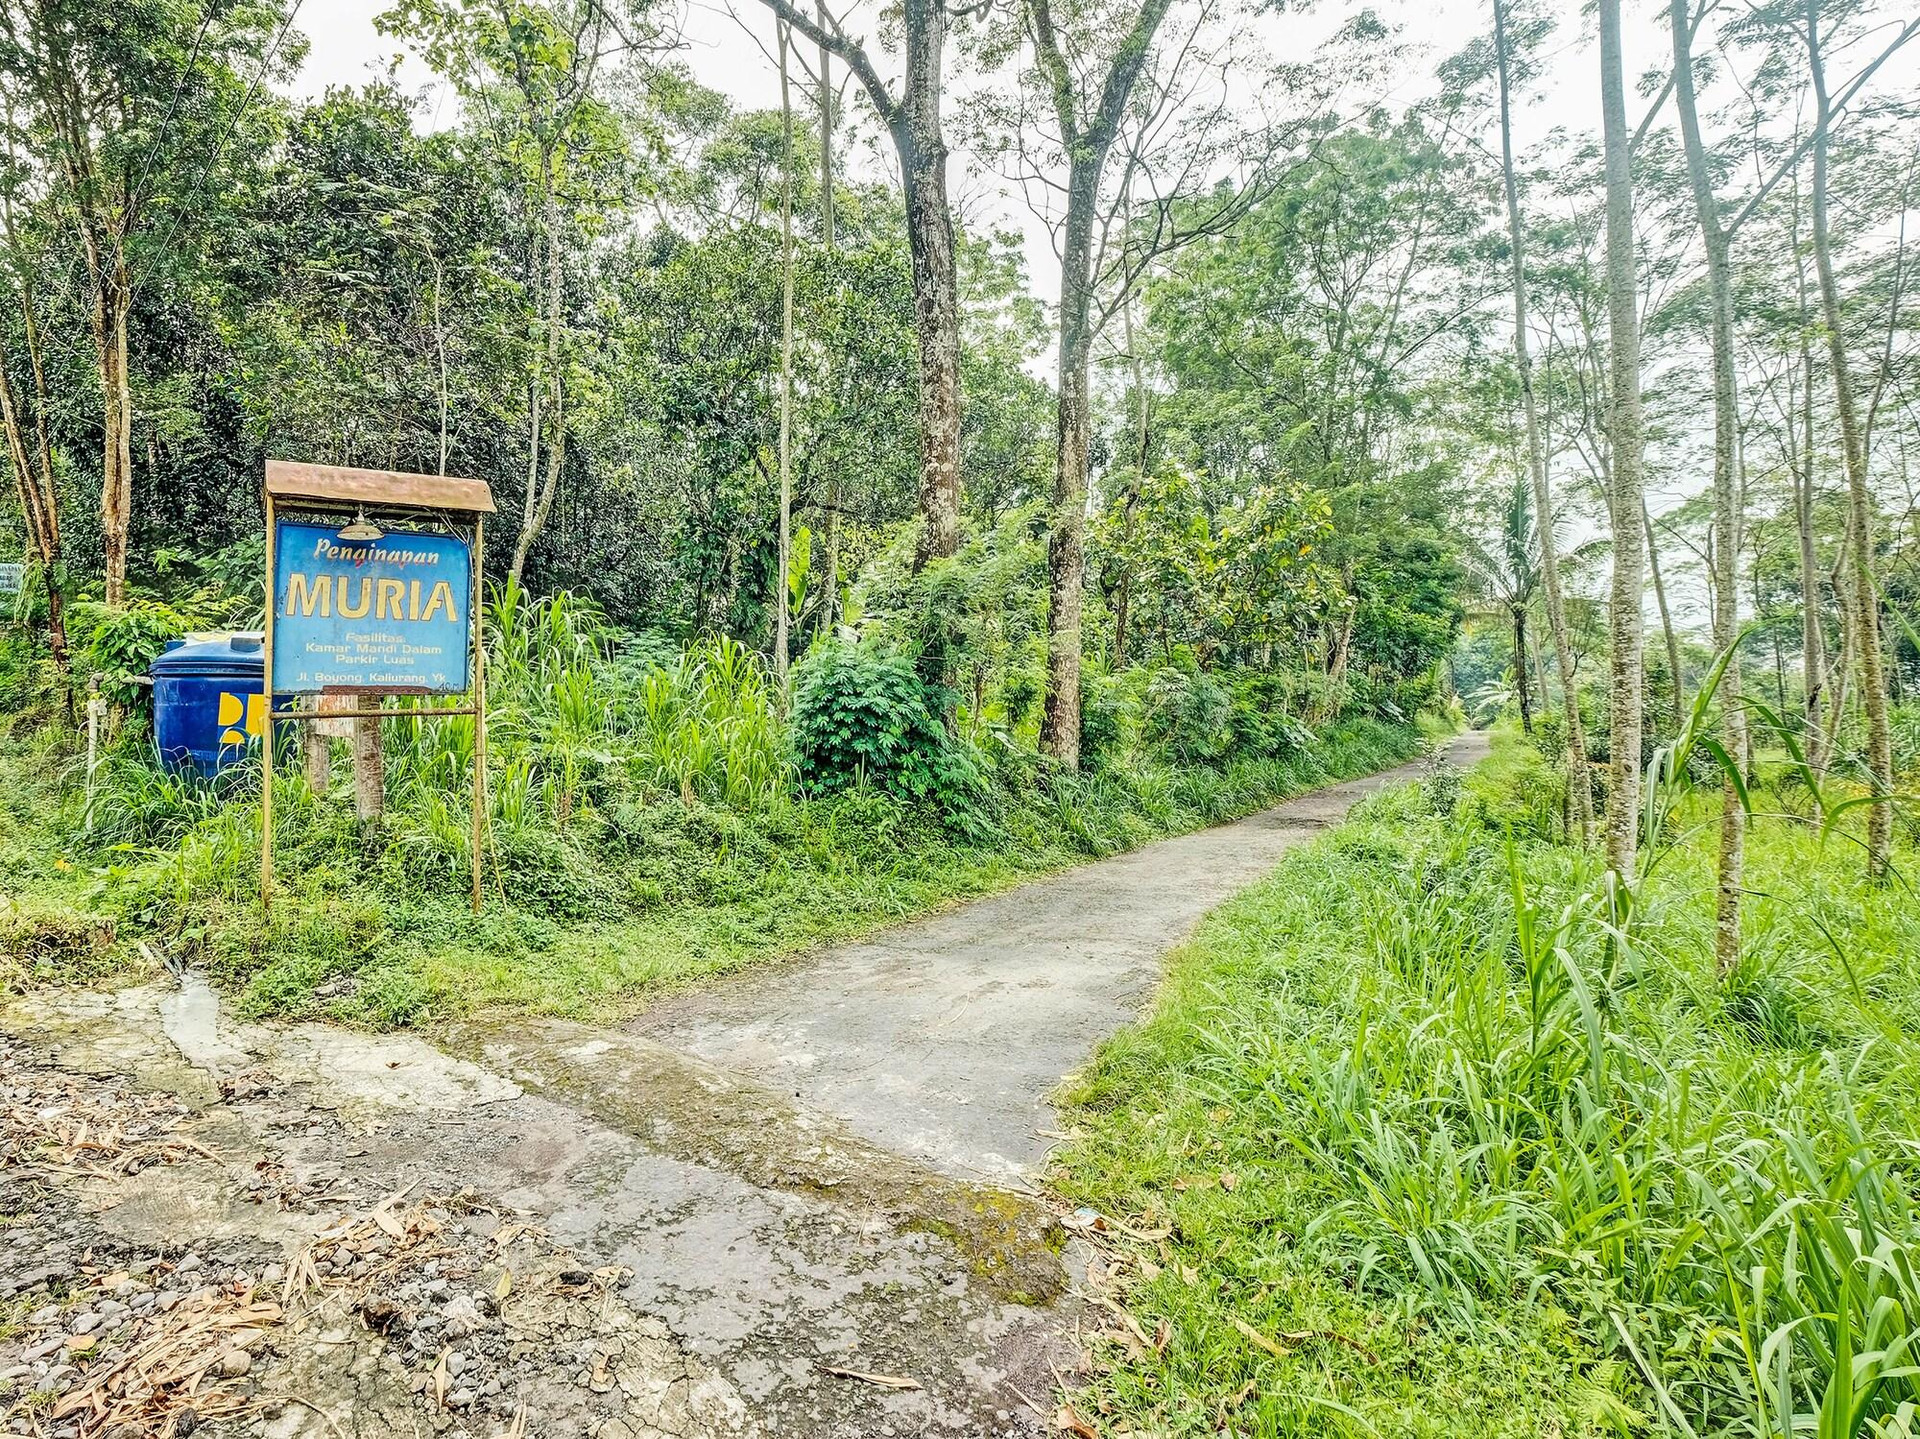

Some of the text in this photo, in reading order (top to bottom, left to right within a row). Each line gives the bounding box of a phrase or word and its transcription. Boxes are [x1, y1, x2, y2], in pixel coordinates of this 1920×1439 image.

[313, 538, 440, 569] Penginapan
[285, 573, 458, 622] MURIA
[306, 643, 442, 654] Kamar Mandi Dalam
[335, 654, 414, 665] Parkir Luas
